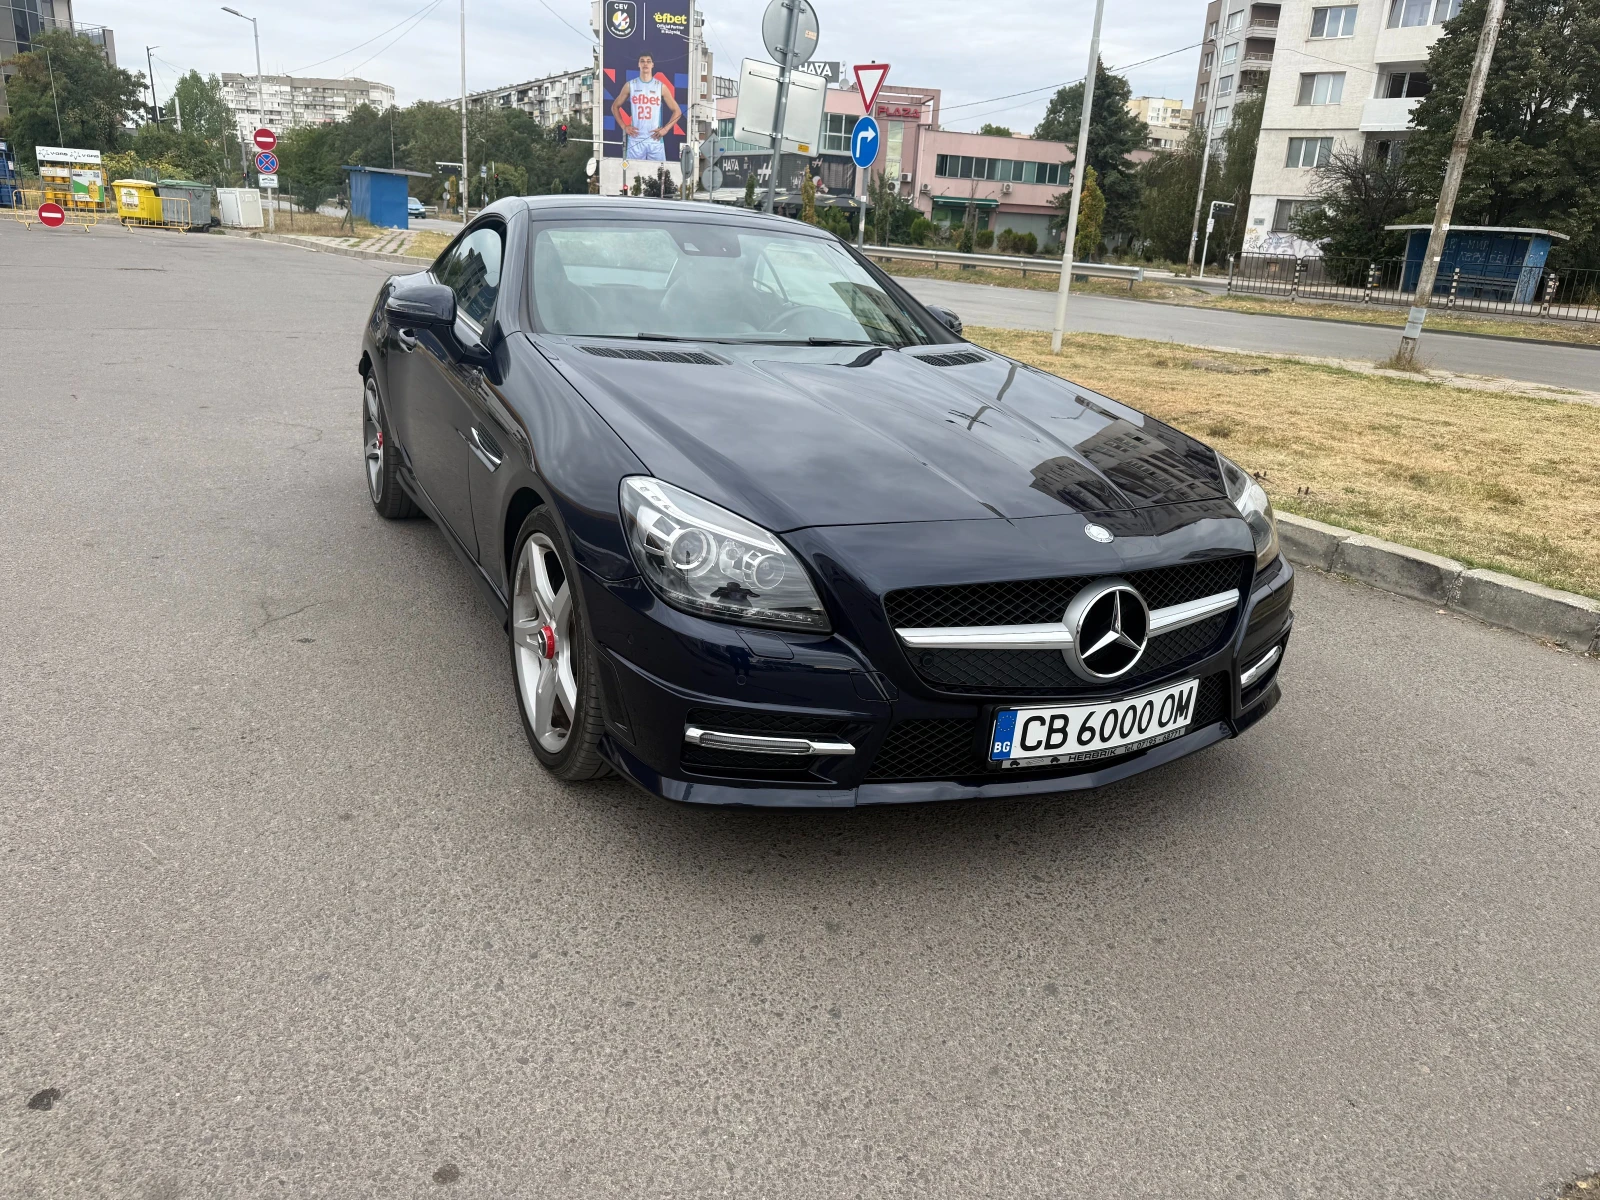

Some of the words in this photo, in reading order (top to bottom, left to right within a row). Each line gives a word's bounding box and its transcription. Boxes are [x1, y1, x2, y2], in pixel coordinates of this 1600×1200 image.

[653, 12, 687, 24] efbet
[631, 94, 660, 106] efbet
[638, 106, 652, 120] 23
[877, 106, 920, 118] PLAZA
[1020, 713, 1070, 752] CB
[1076, 699, 1154, 746] 6000
[1157, 686, 1194, 728] OM
[993, 741, 1011, 753] BG
[1068, 748, 1117, 762] HERBRIK
